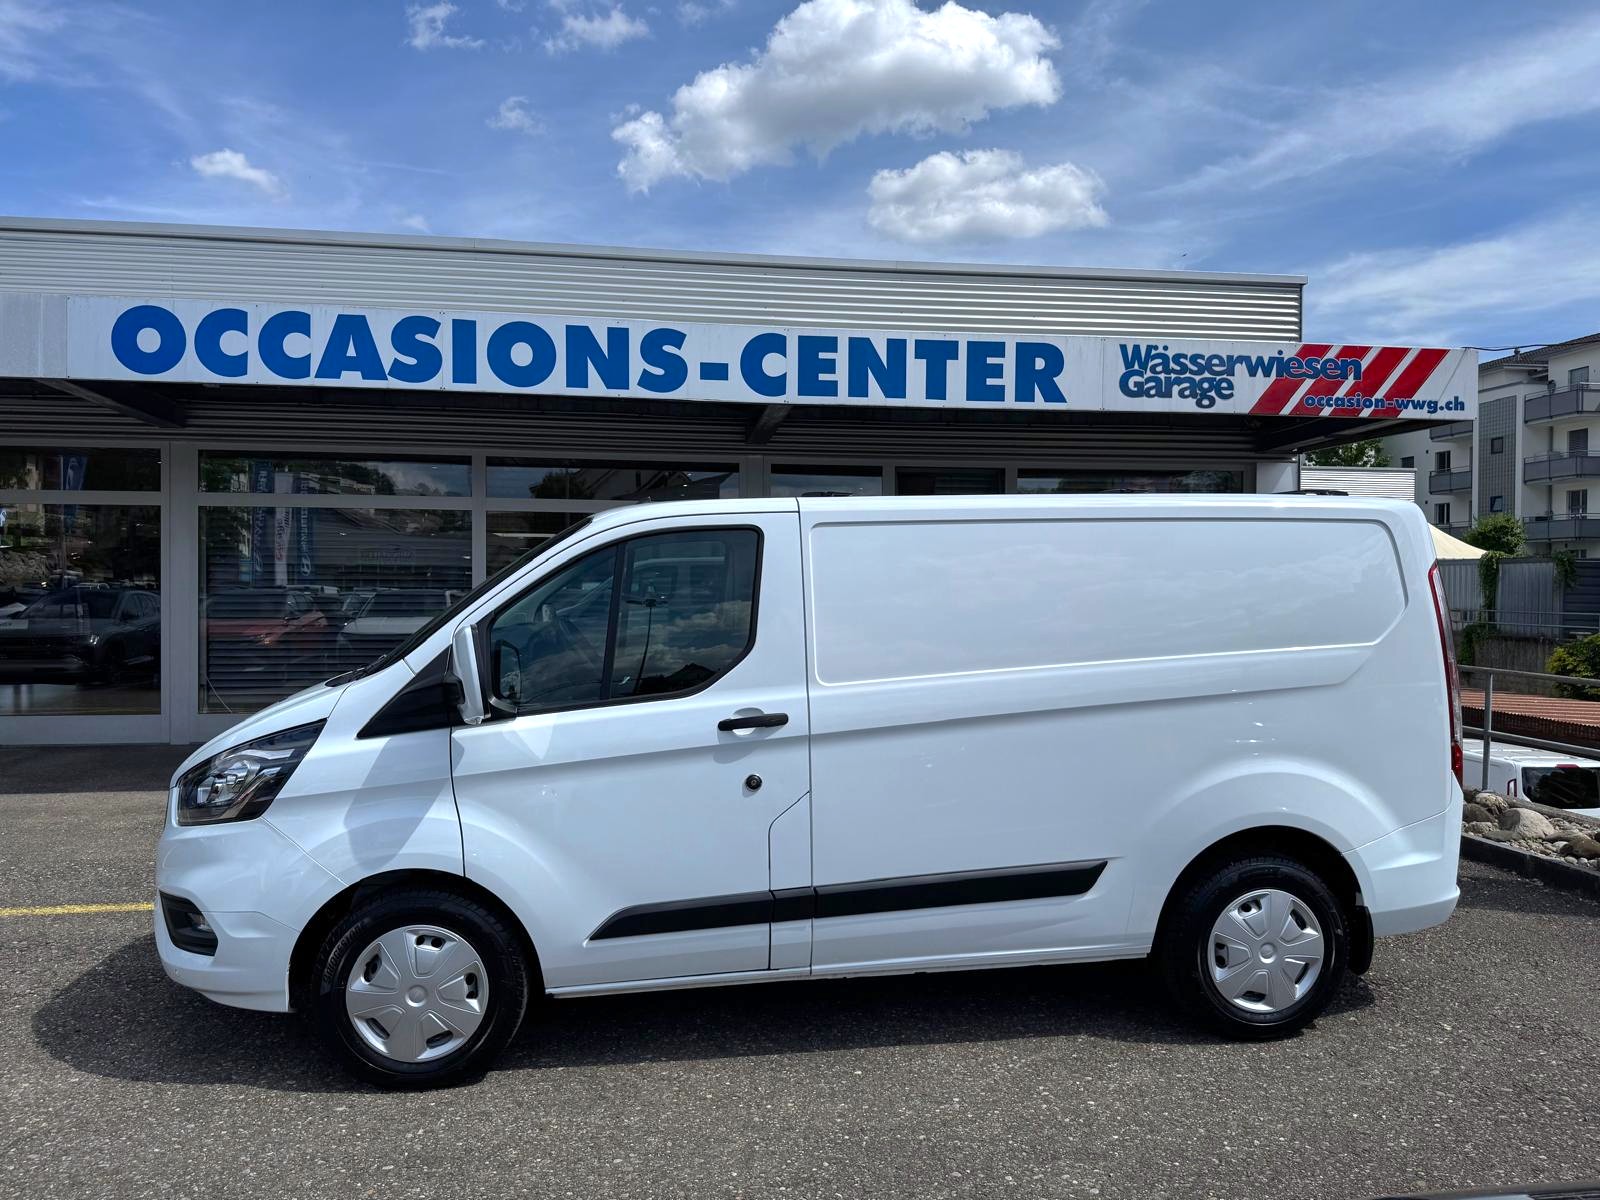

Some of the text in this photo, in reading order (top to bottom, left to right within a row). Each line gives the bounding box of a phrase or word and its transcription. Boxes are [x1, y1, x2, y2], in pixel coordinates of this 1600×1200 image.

[111, 304, 1068, 404] OCCASIONS-CENTER
[1119, 343, 1362, 380] Wässerwiesen
[1118, 369, 1234, 409] Garage
[1304, 394, 1465, 414] occasion-wwg.ch
